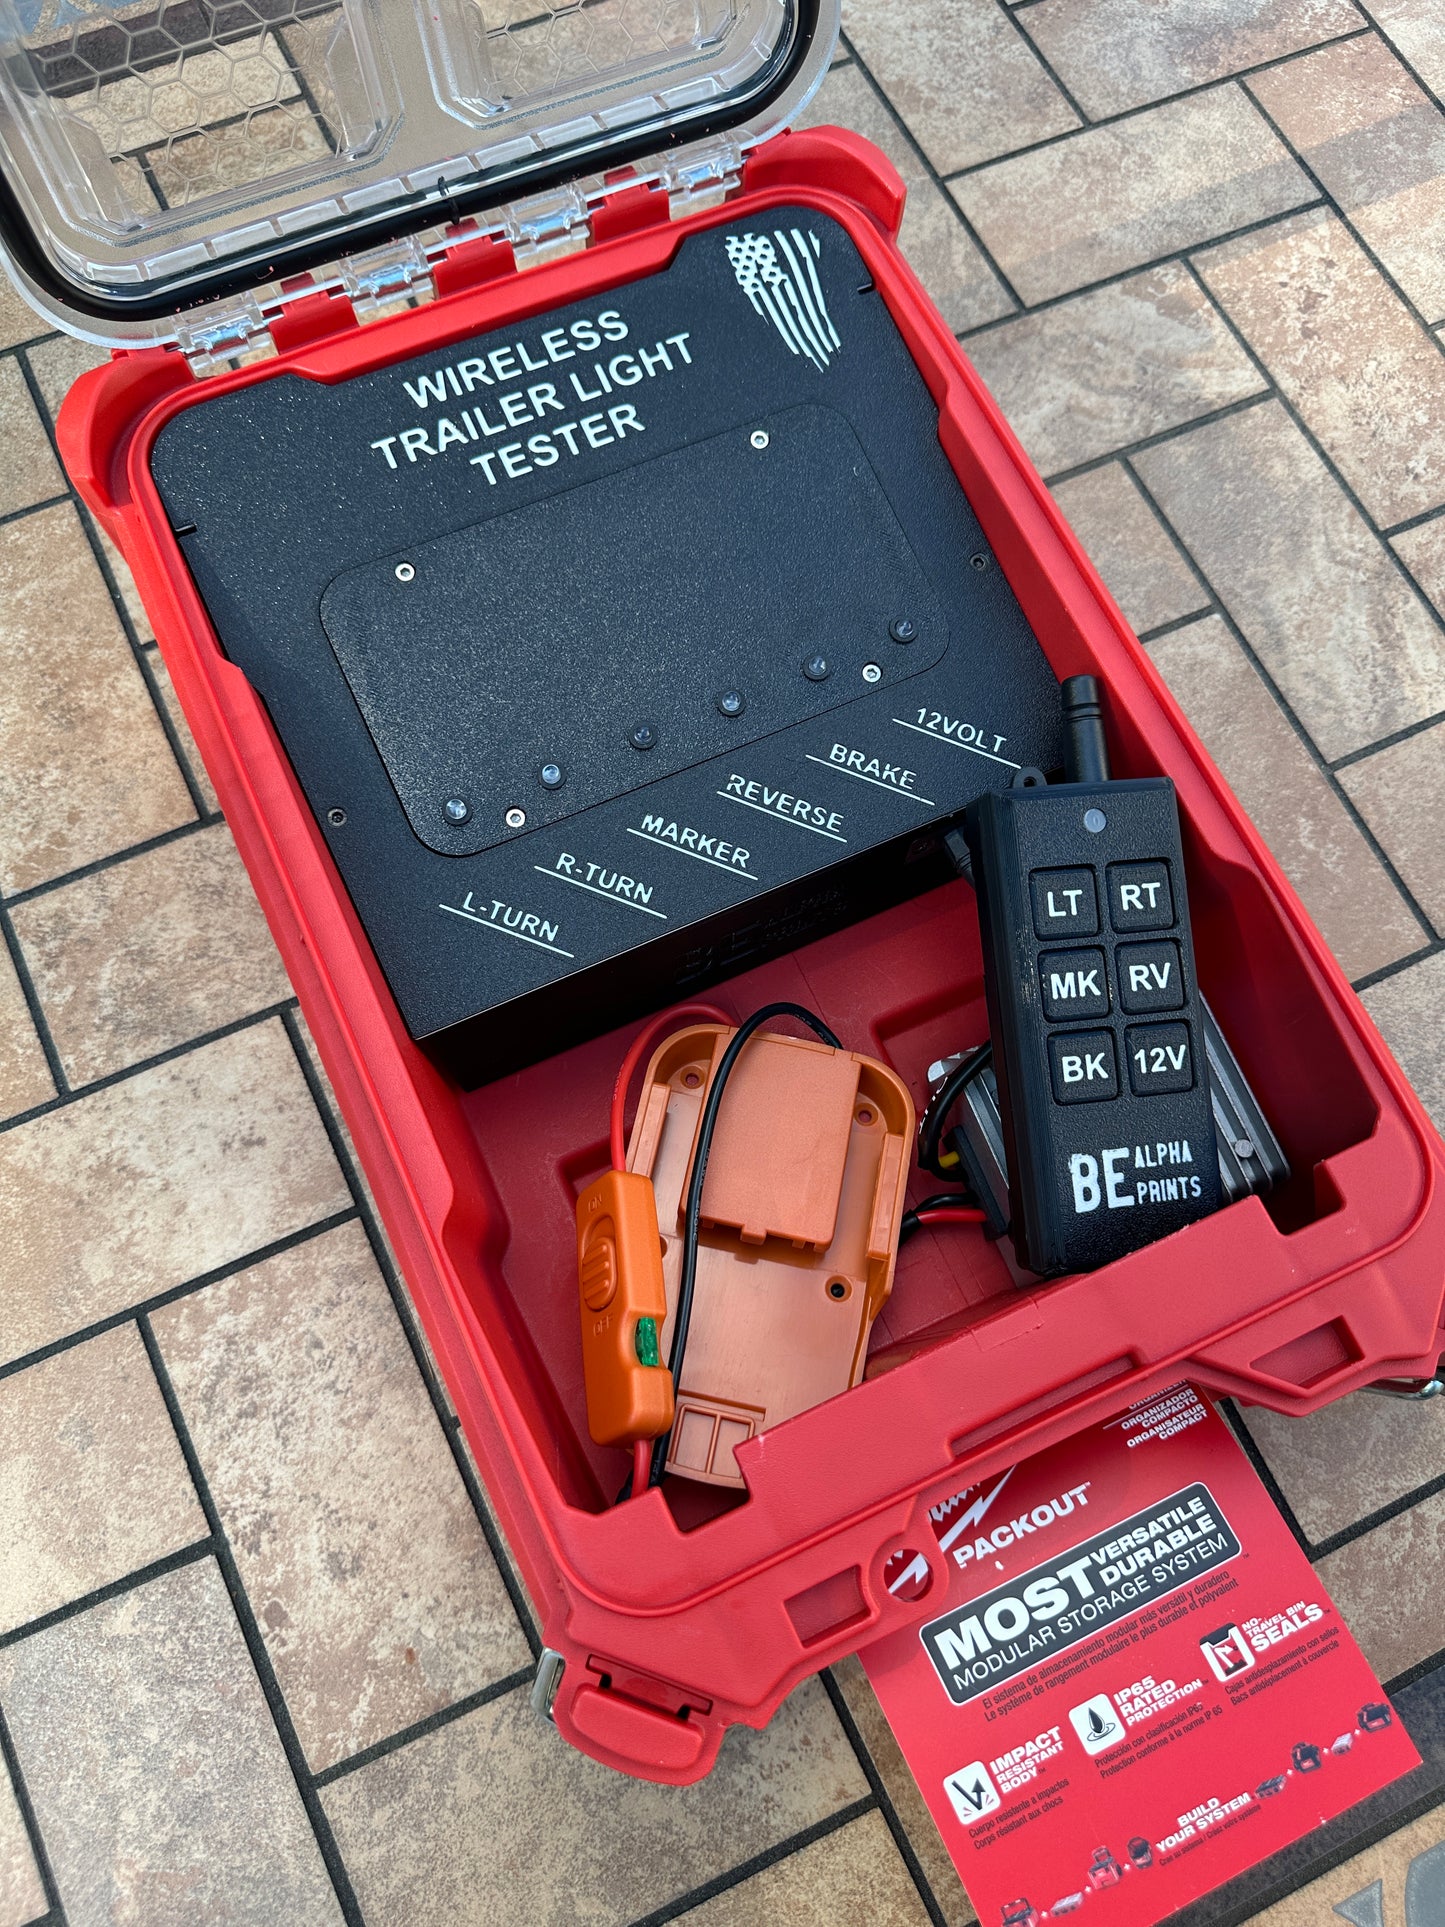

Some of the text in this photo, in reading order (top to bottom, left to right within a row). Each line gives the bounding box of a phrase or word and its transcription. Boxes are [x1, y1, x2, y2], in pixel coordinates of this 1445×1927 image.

[403, 311, 628, 408] WIRELESS
[370, 333, 691, 469] TRAILER LIGHT
[470, 404, 645, 485] TESTER
[918, 708, 1007, 752] 12VOLT
[830, 744, 916, 789] BRAKE
[727, 774, 844, 832] REVERSE
[641, 815, 750, 868] MARKER
[556, 853, 653, 903] R-TURN
[1120, 882, 1160, 910] RT
[463, 892, 558, 941] L-TURN
[1047, 890, 1082, 917] LT
[1051, 970, 1101, 999] MK
[1129, 962, 1170, 991] RV
[1062, 1053, 1108, 1083] BK
[1135, 1045, 1186, 1073] 12V
[1068, 1140, 1192, 1213] BE ALPHA
[1137, 1176, 1200, 1204] PRINTS
[1122, 1389, 1193, 1429] ORGANIZADOR
[1127, 1404, 1205, 1447] ORGANISATEUR
[1140, 1396, 1197, 1427] COMPACTO
[1158, 1410, 1207, 1439] COMPACT
[1099, 1513, 1216, 1586] DURABLE
[934, 1556, 1096, 1670] MOST
[1090, 1497, 1206, 1565] VERSATILE
[953, 1533, 1228, 1690] MODULAR STORAGE SYSTEM
[1241, 1618, 1263, 1631] NO-
[1246, 1601, 1306, 1638] TRAVEL BIN
[1251, 1604, 1324, 1652] SEALS
[982, 1571, 1229, 1709] El sistema de almacenamiento modular más versátil y duradero
[984, 1578, 1239, 1722] Le système de rangement modulaire le plus durable et polyvalent
[1225, 1680, 1245, 1695] Cajas
[1307, 1638, 1320, 1648] con
[1319, 1627, 1339, 1642] sellos
[1113, 1675, 1156, 1706] IP65
[1119, 1680, 1176, 1718] RATED
[1126, 1679, 1203, 1727] PROTECTION
[1230, 1692, 1248, 1706] Bacs
[989, 1726, 1061, 1776] IMPACT
[996, 1741, 1063, 1785] RESISTANT
[1095, 1744, 1132, 1768] Protección
[1132, 1736, 1145, 1747] con
[1100, 1755, 1136, 1779] Protection
[1136, 1737, 1169, 1759] conforme
[1174, 1729, 1182, 1737] la
[1183, 1717, 1205, 1733] norme
[1204, 1711, 1211, 1720] IP
[1212, 1705, 1222, 1716] 65
[1000, 1766, 1037, 1794] BODY
[969, 1820, 995, 1838] Cuerpo
[995, 1800, 1030, 1824] resistente
[1036, 1779, 1069, 1800] impactos
[974, 1796, 1063, 1850] Corps résistant aux chocs
[1156, 1792, 1252, 1853] YOUR SYSTEM
[1177, 1798, 1220, 1828] BUILD
